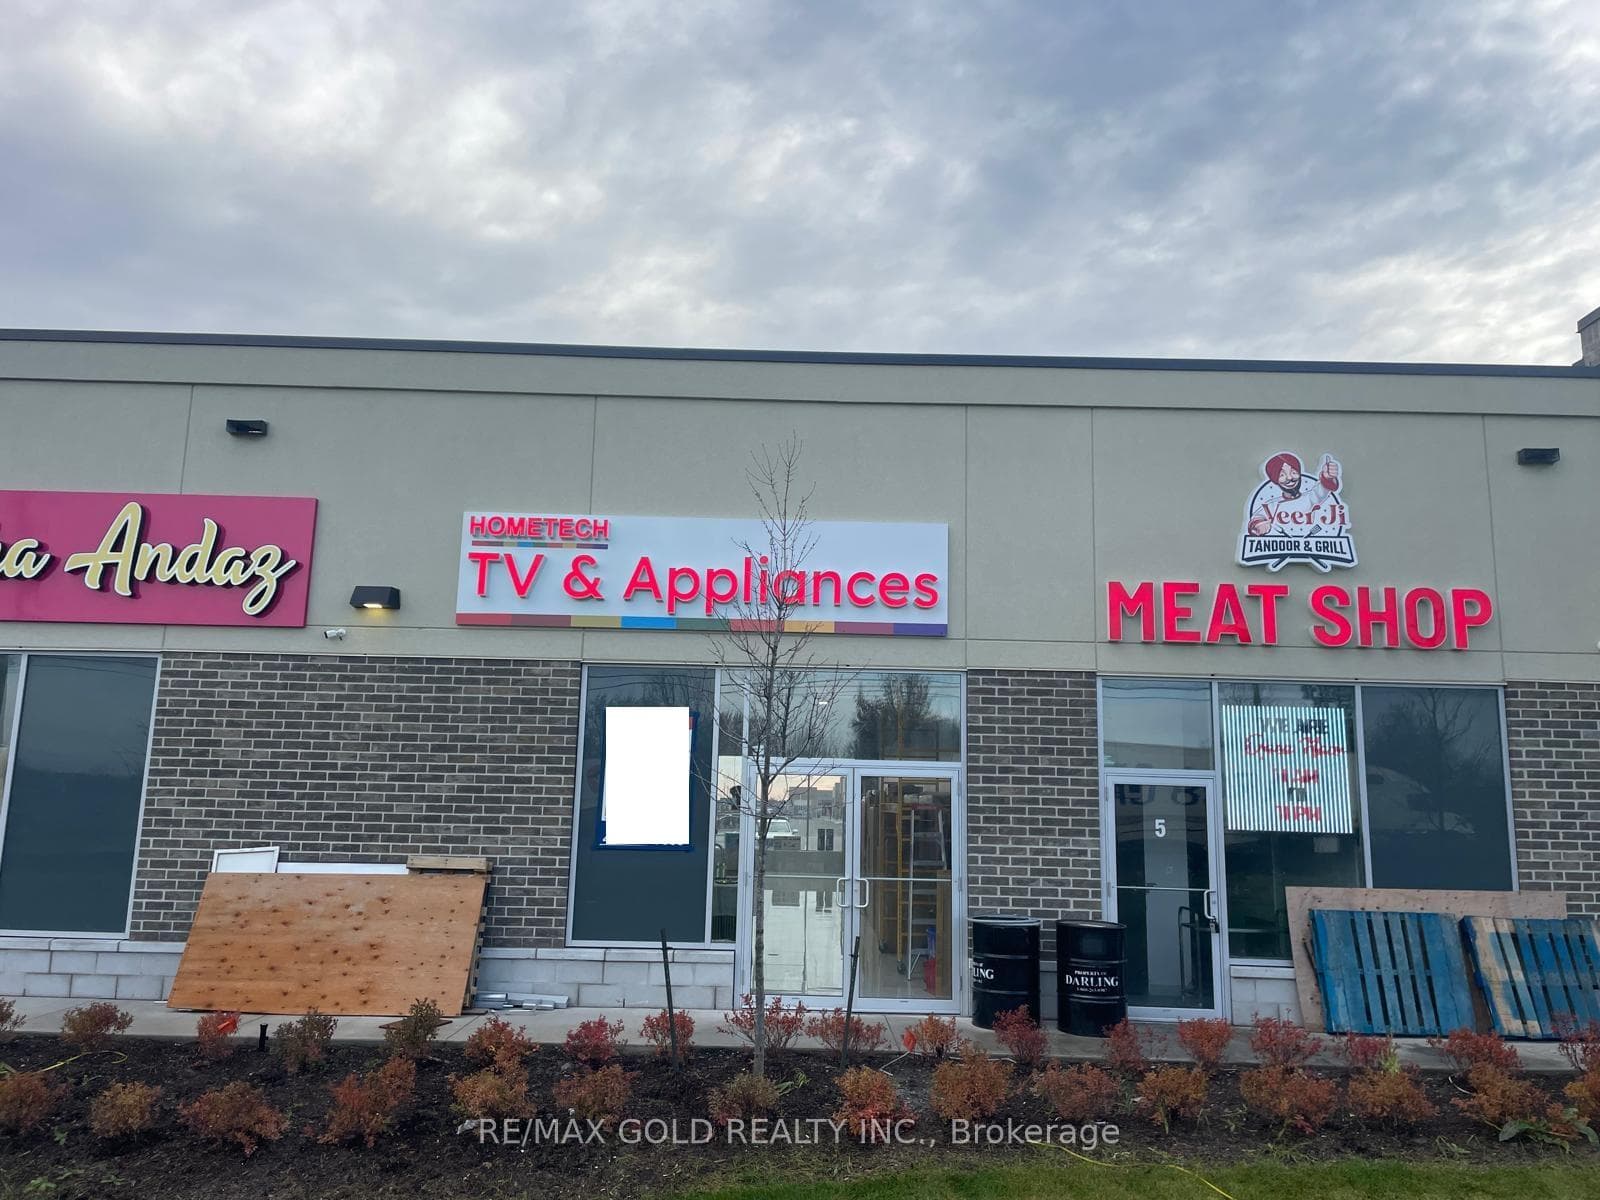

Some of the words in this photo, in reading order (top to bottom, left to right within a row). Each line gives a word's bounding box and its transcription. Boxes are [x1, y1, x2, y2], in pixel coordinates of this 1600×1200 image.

[1321, 503, 1346, 526] Ji
[469, 514, 610, 542] HOMETECH
[64, 501, 297, 616] Andaz
[1249, 539, 1300, 553] TANDOOR
[1303, 540, 1313, 553] &
[1315, 541, 1347, 555] GRILL
[468, 551, 545, 599] TV
[562, 554, 605, 601] &
[623, 555, 940, 616] Appliances
[1107, 581, 1290, 645] MEAT
[1309, 585, 1494, 650] SHOP
[1155, 818, 1167, 838] 5
[1065, 975, 1119, 987] DARLING
